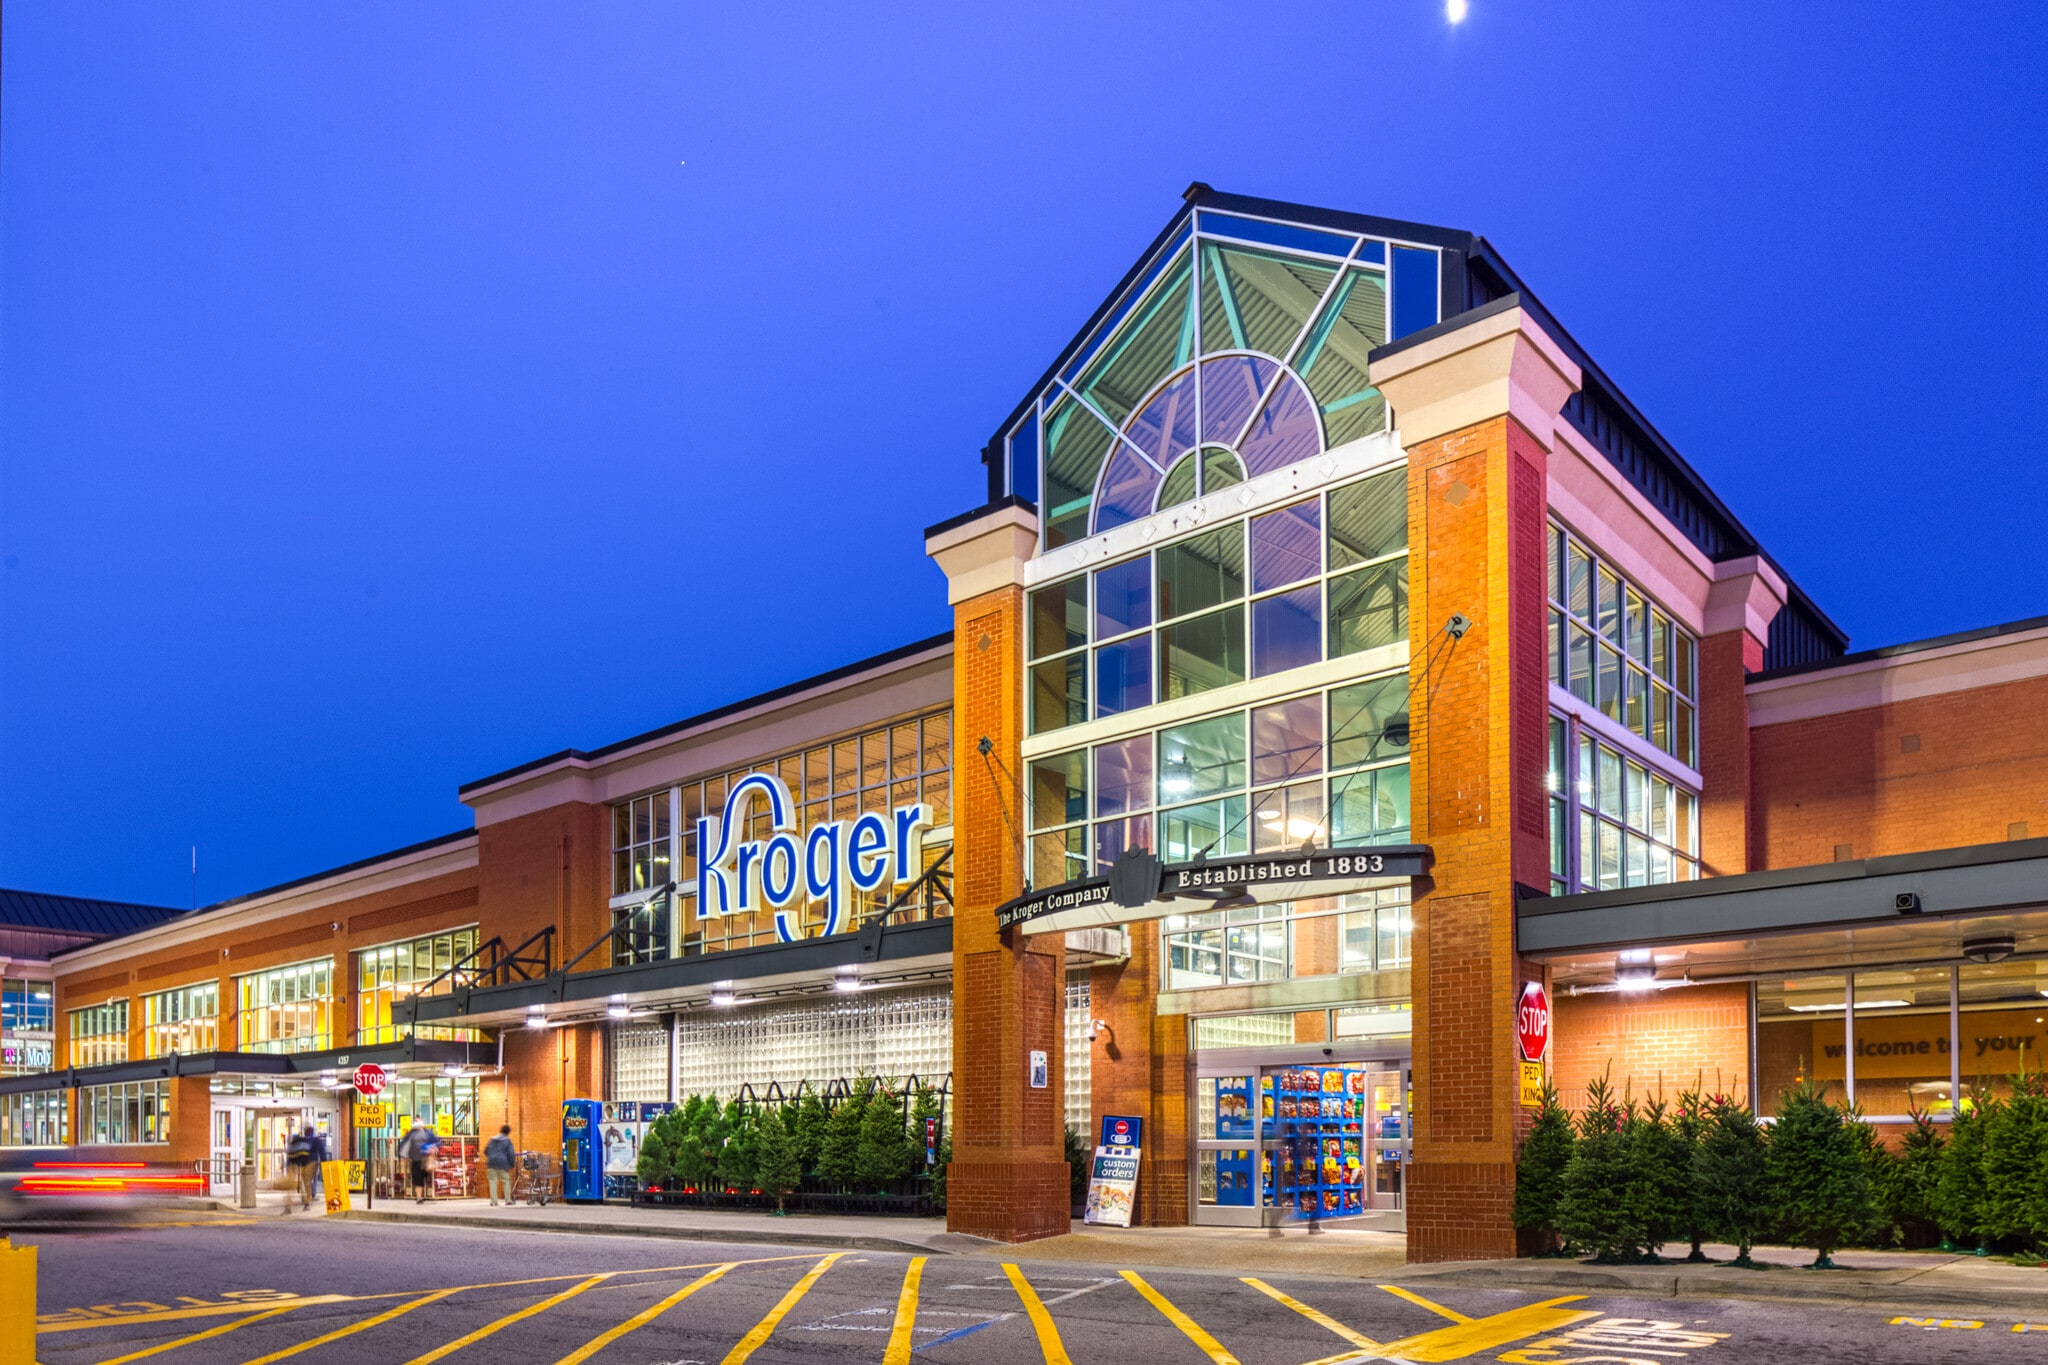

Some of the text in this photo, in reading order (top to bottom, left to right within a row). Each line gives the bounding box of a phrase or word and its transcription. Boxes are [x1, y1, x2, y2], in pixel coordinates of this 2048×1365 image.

[696, 772, 933, 943] Kroger
[1178, 854, 1384, 888] Established 1883
[1000, 885, 1111, 927] The Kroger Company
[1520, 1005, 1547, 1037] STOP
[1975, 1035, 2036, 1057] your
[355, 1074, 385, 1087] STOP
[1524, 1065, 1540, 1081] PED
[360, 1106, 380, 1115] PED
[359, 1117, 382, 1126] XING
[1103, 1159, 1135, 1169] custom
[1101, 1167, 1134, 1178] orders
[1889, 1315, 1985, 1330] NO
[1495, 1317, 1733, 1365] STOP
